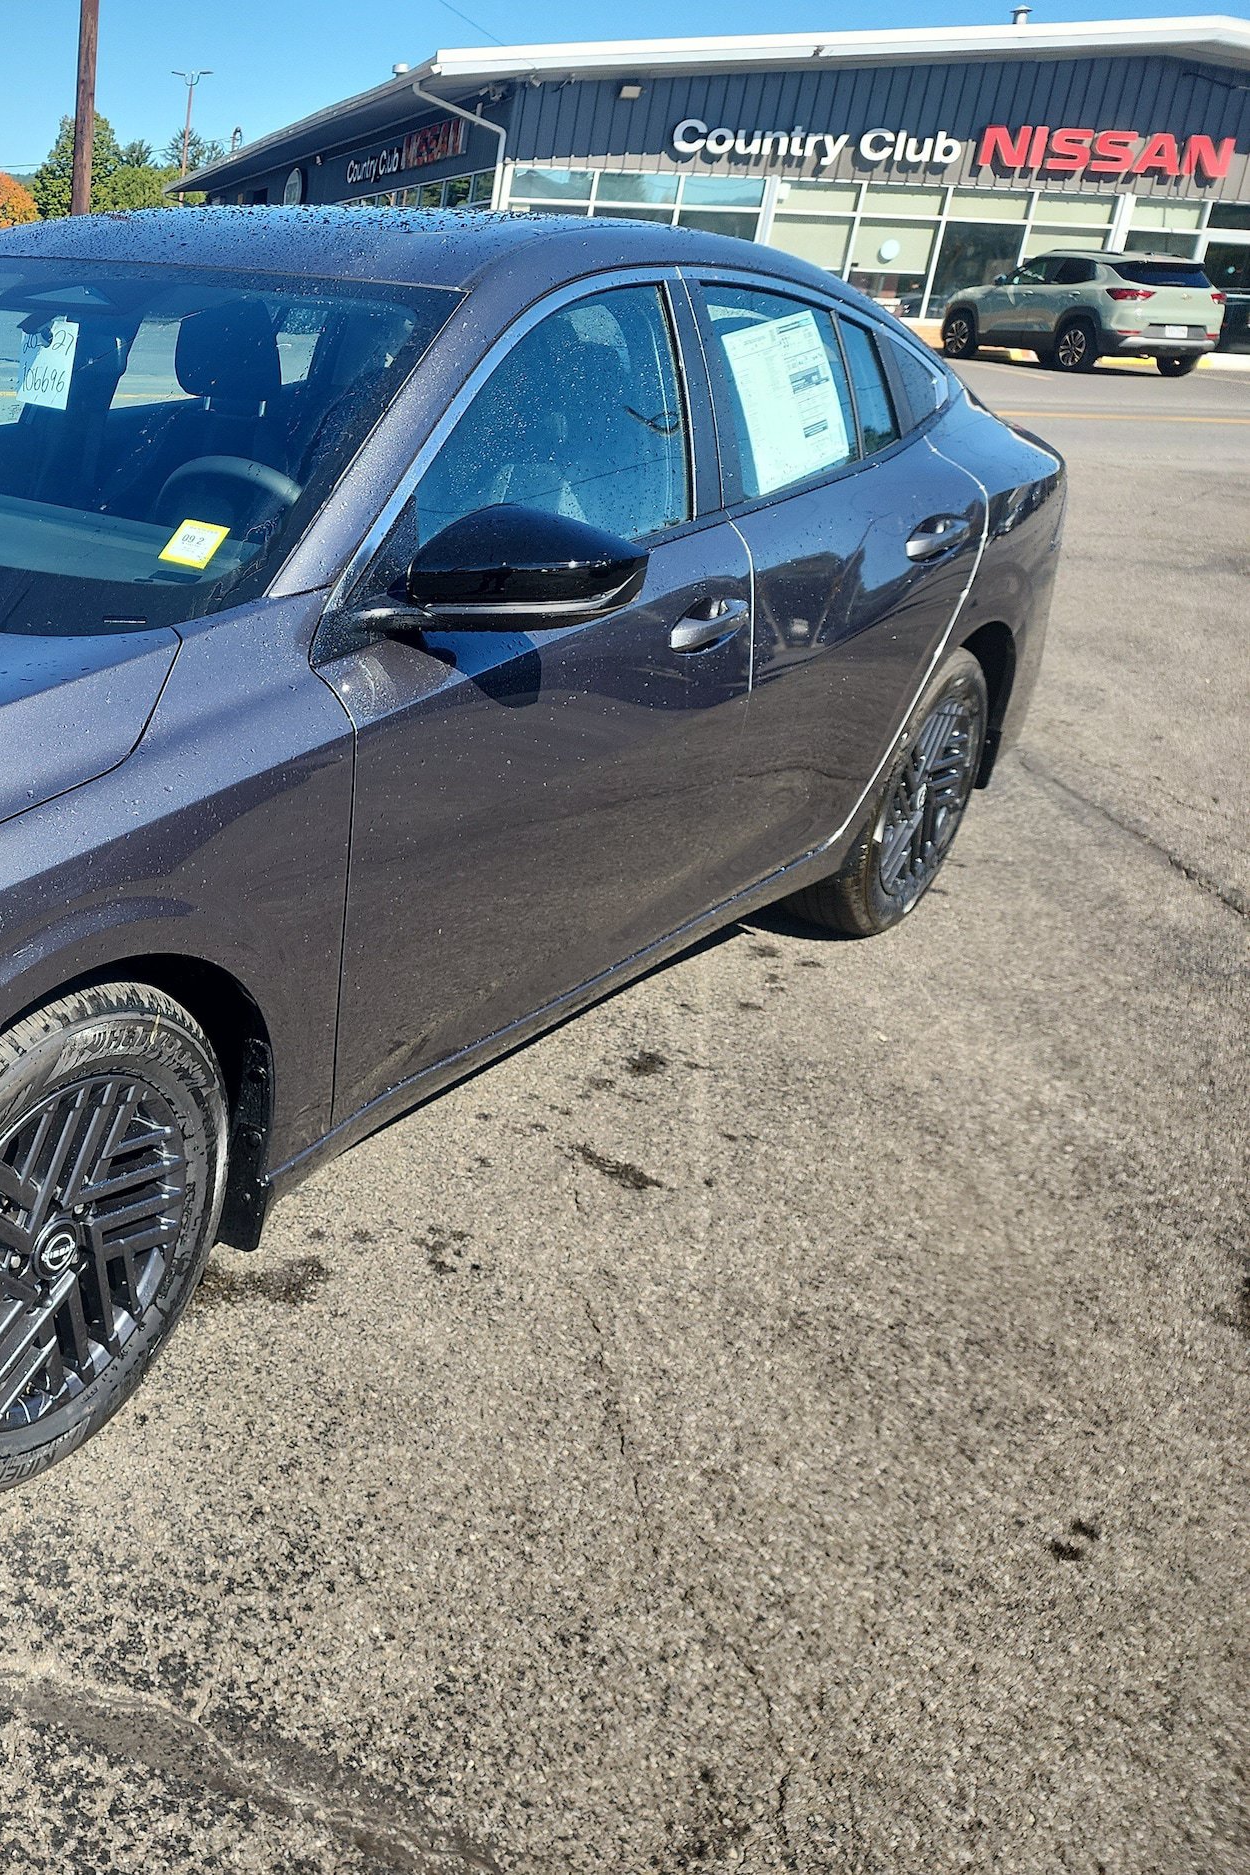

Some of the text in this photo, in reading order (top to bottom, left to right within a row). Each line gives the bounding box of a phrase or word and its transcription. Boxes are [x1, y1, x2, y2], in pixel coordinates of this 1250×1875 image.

[347, 156, 379, 184] Country
[378, 147, 400, 175] Club
[672, 119, 1235, 178] Country Club NISSAN
